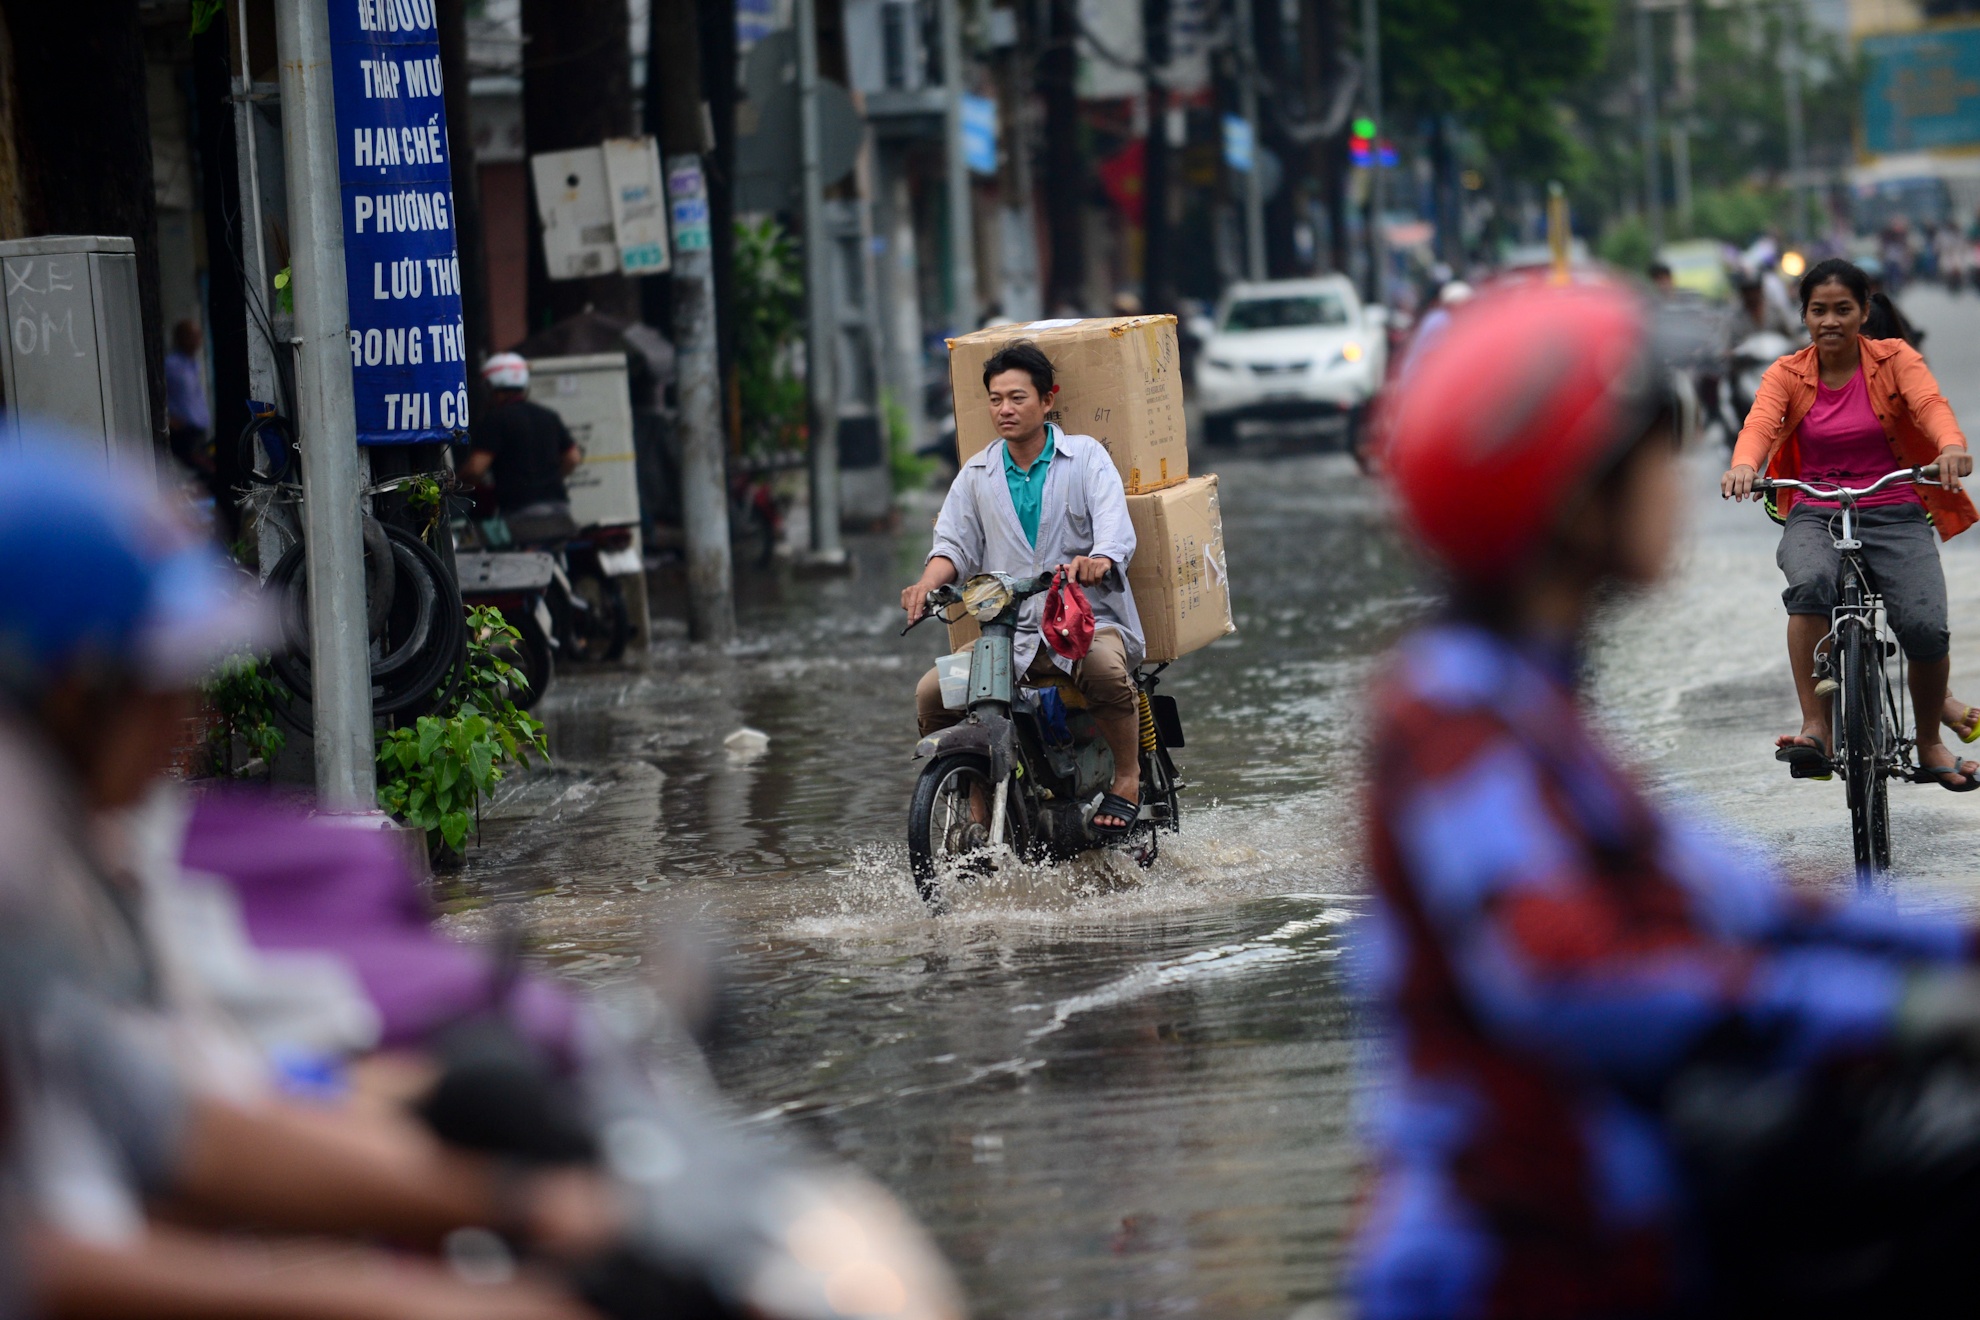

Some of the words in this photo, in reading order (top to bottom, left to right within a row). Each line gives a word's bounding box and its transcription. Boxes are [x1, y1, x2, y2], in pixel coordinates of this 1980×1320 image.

[360, 53, 400, 98] THÁP
[404, 54, 443, 98] MƯ
[354, 128, 400, 174] HẠN
[401, 113, 444, 166] CHẾ
[355, 190, 449, 234] PHƯƠNG
[5, 261, 74, 296] XE
[374, 257, 423, 299] LƯU
[384, 393, 431, 430] THI
[440, 382, 469, 429] CÔ
[1094, 407, 1111, 423] 617
